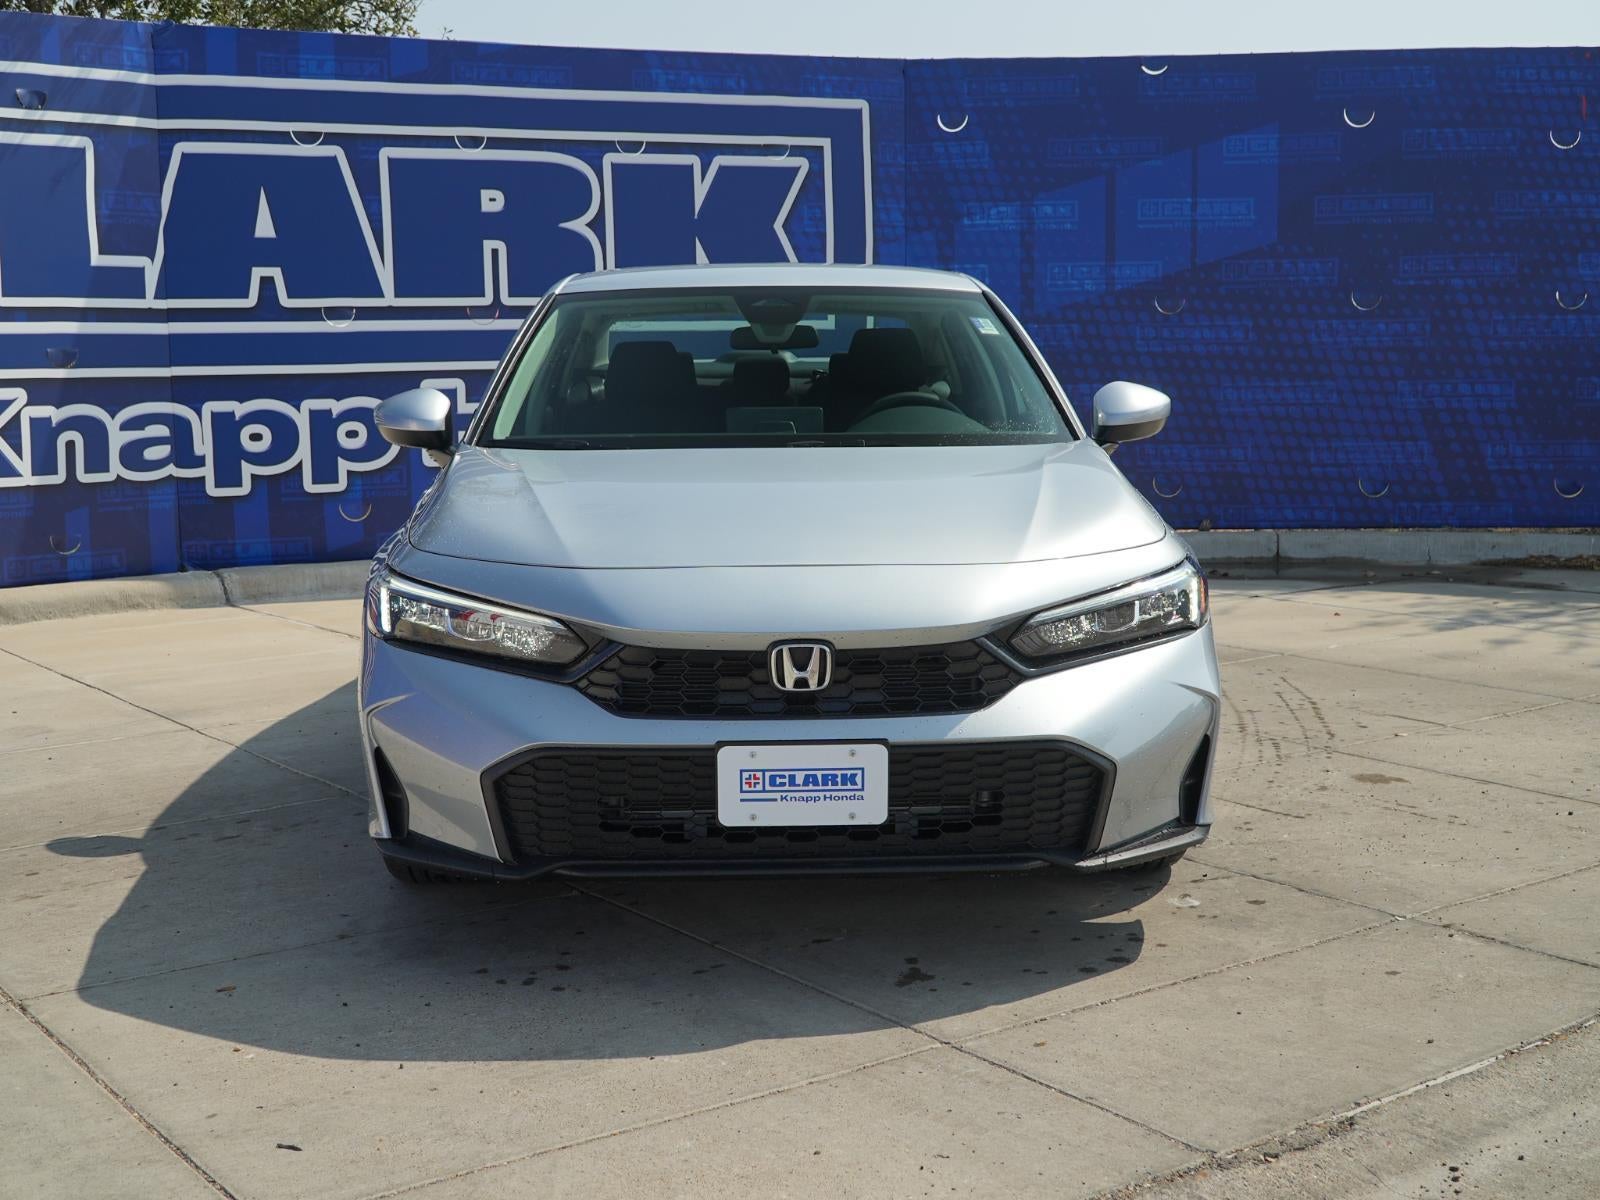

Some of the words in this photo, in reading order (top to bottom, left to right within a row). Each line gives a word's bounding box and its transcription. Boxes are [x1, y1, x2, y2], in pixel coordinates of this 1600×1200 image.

[768, 773, 858, 787] CLARK
[780, 794, 821, 804] Knapp
[823, 793, 864, 802] Honda
